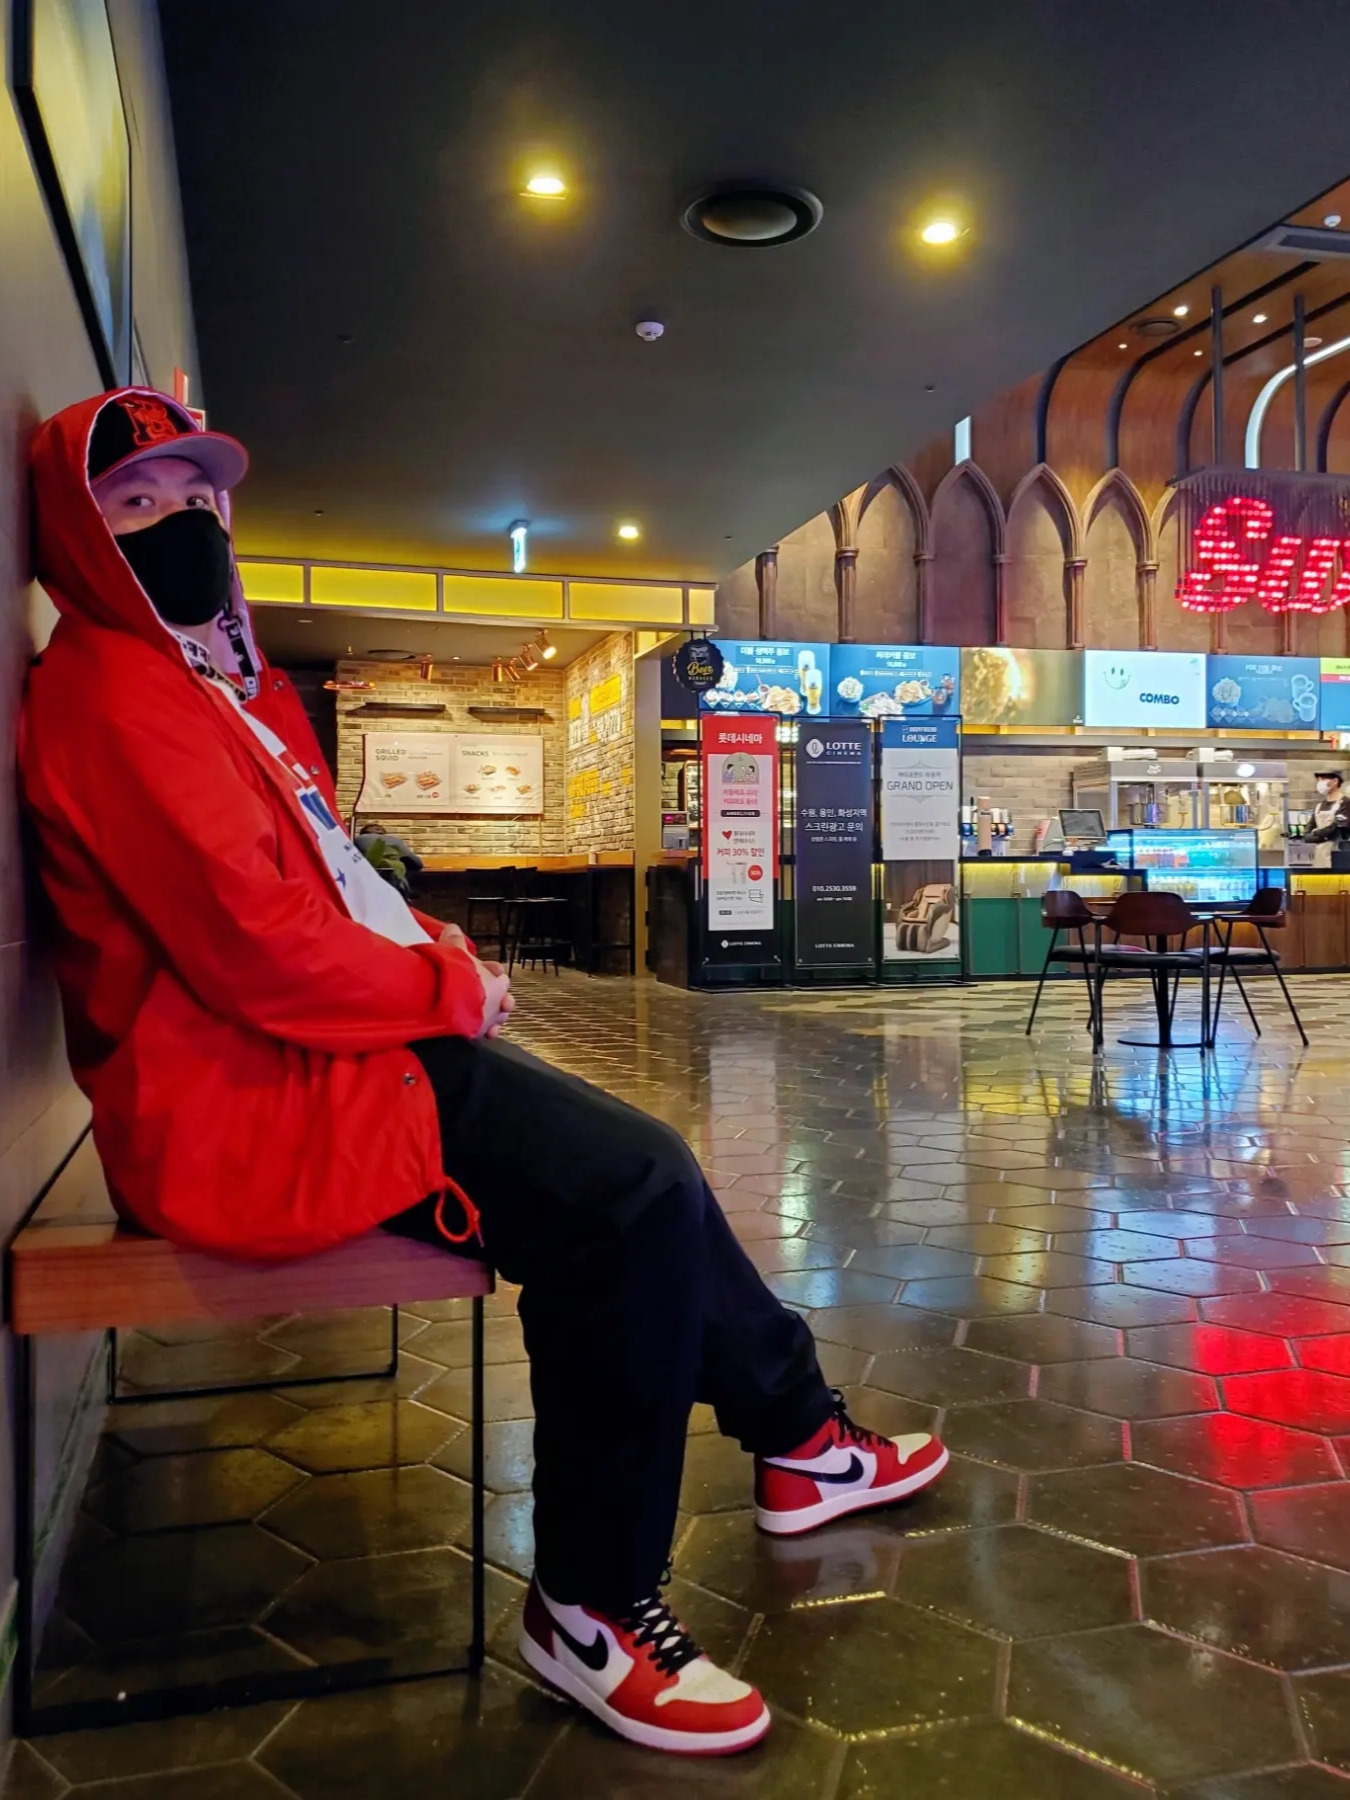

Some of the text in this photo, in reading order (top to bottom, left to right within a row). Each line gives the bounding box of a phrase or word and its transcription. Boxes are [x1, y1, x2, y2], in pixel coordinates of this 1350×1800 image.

[687, 661, 714, 676] Beer
[1139, 693, 1180, 705] COMBO
[718, 732, 763, 744] 롯데시네마
[902, 734, 937, 743] LOUNGE
[825, 742, 862, 750] LOTTE
[887, 781, 953, 791] GRAND OPEN
[800, 808, 868, 818] 수원, 용인, 화성지역
[804, 822, 864, 832] 스크린광고 문의
[716, 847, 765, 857] 커피 30% 할인
